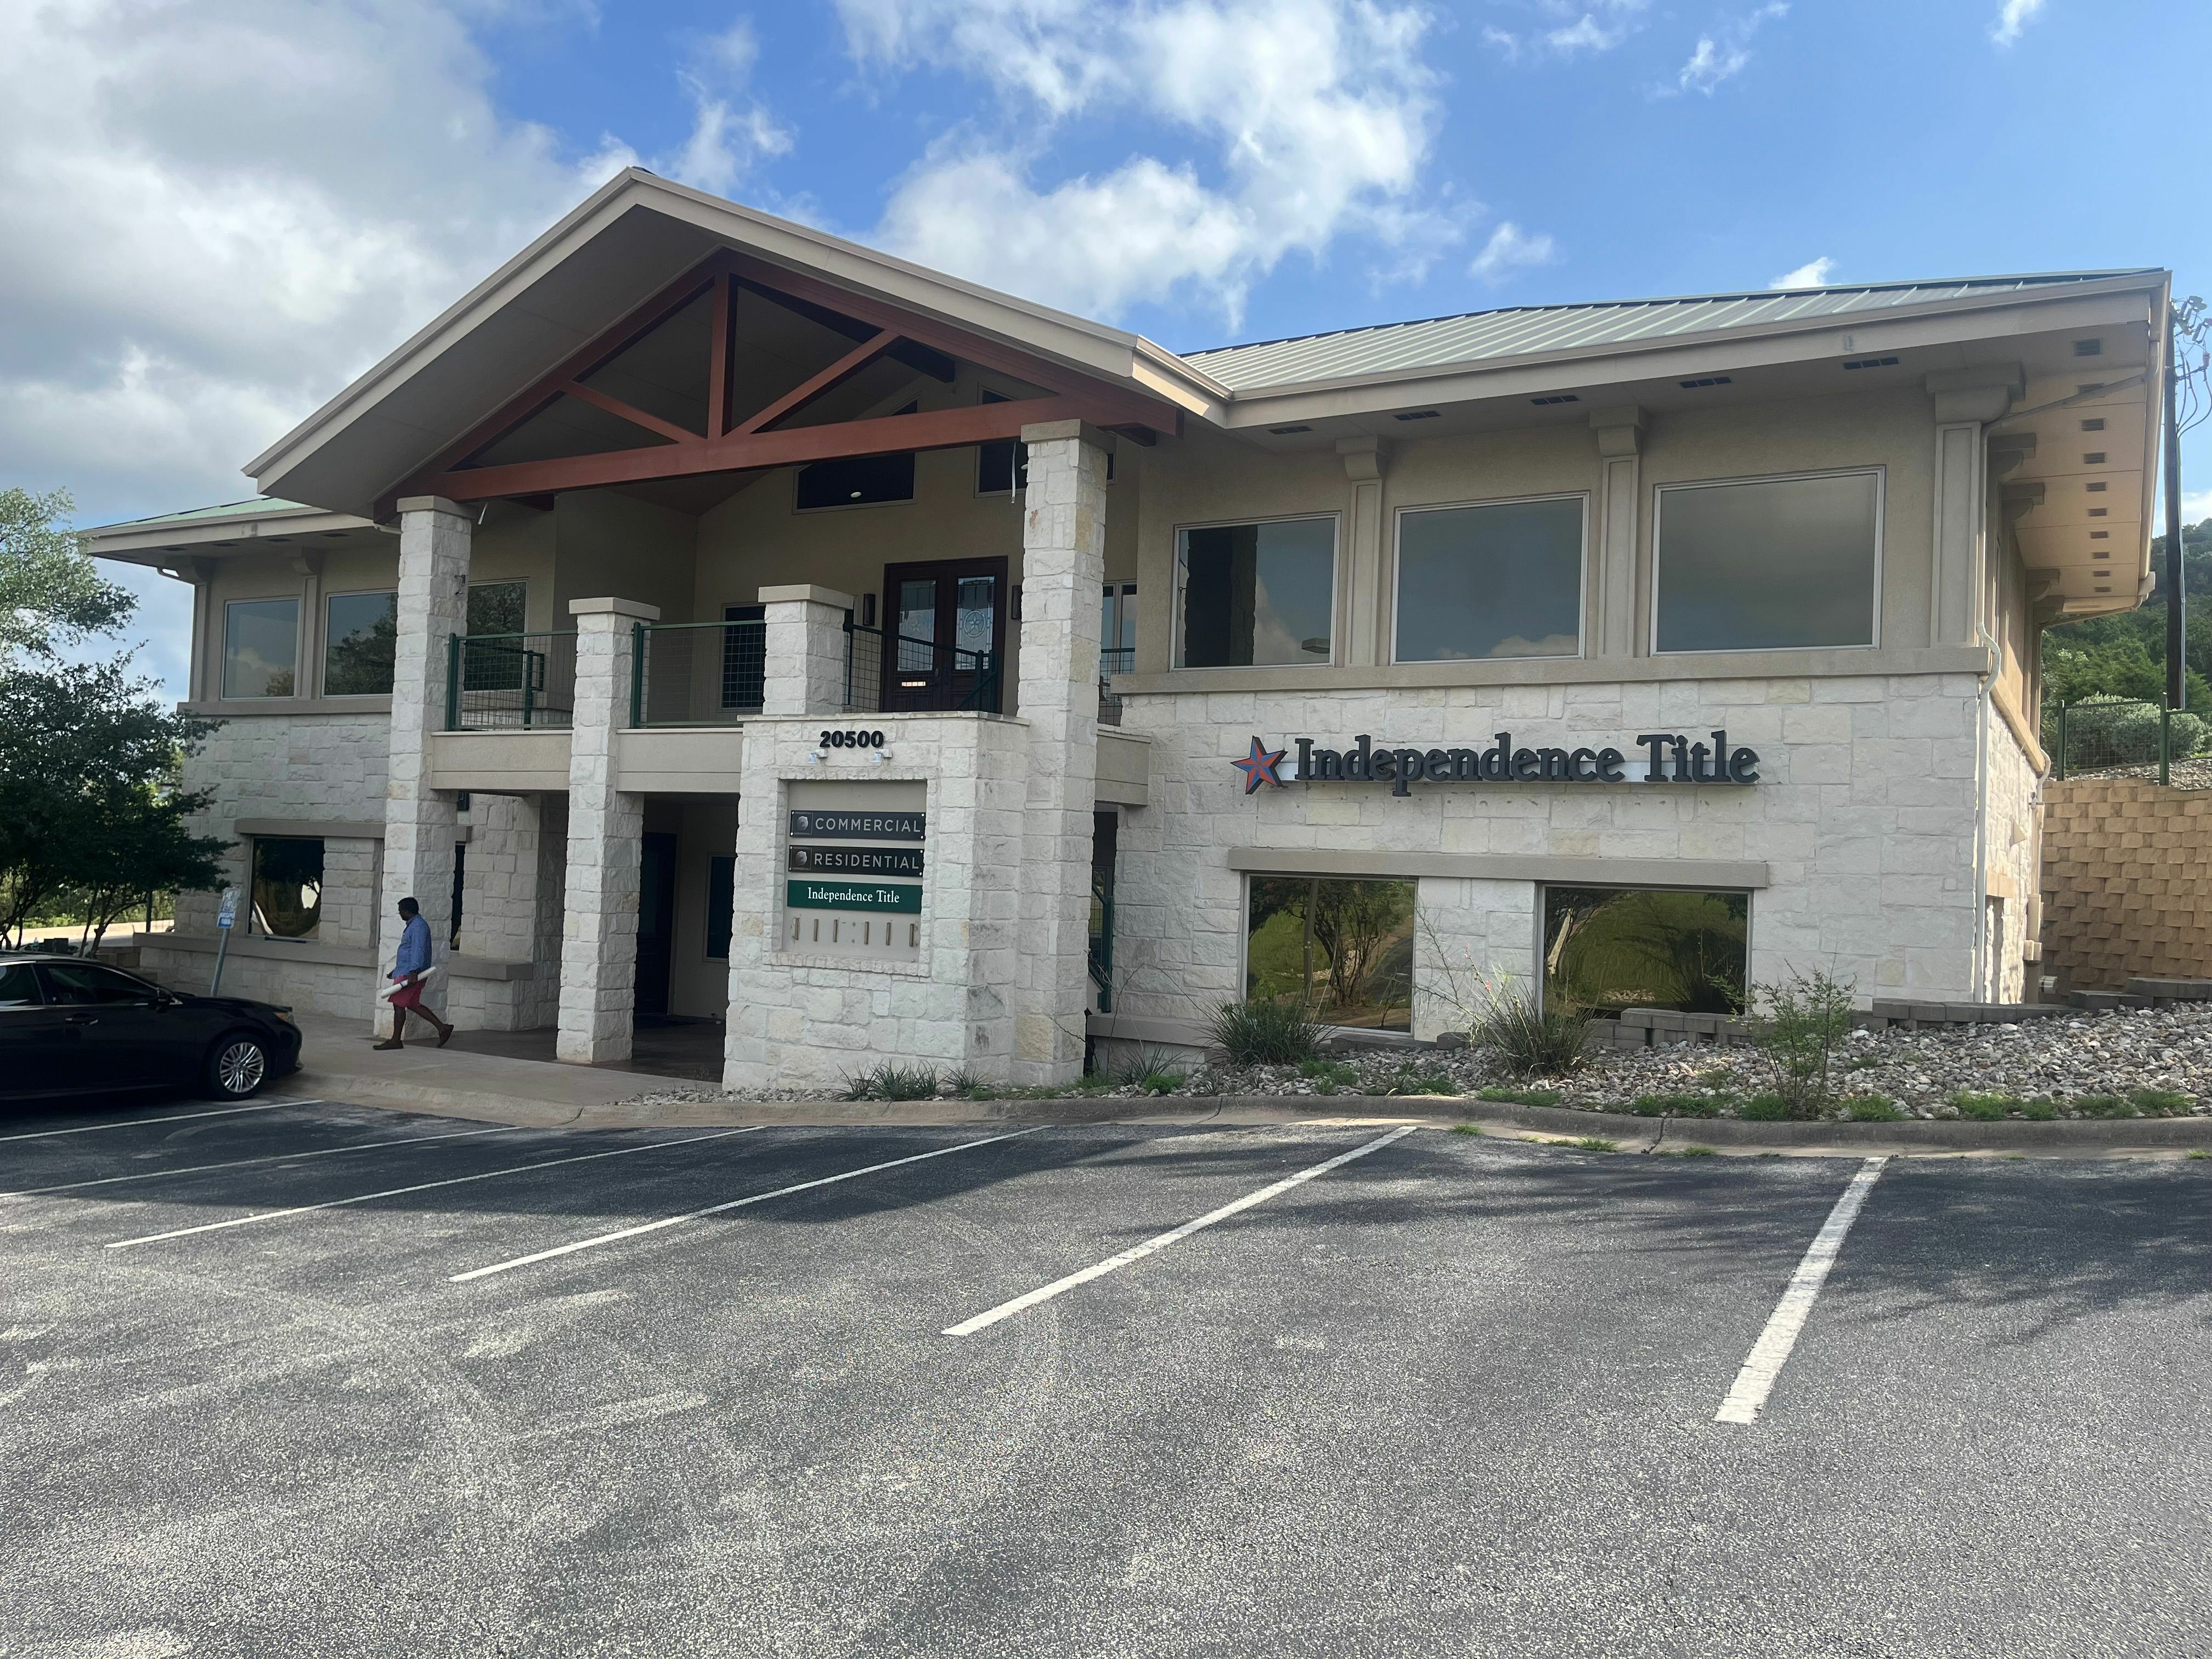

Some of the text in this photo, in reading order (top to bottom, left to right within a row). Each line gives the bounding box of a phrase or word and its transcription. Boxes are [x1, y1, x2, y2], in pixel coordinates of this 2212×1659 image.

[819, 730, 884, 748] 20500
[1295, 730, 1760, 797] Independence Title
[815, 817, 921, 833] COMMERCIAL
[814, 853, 919, 870] RESIDENTIAL
[808, 887, 900, 903] Independence Title
